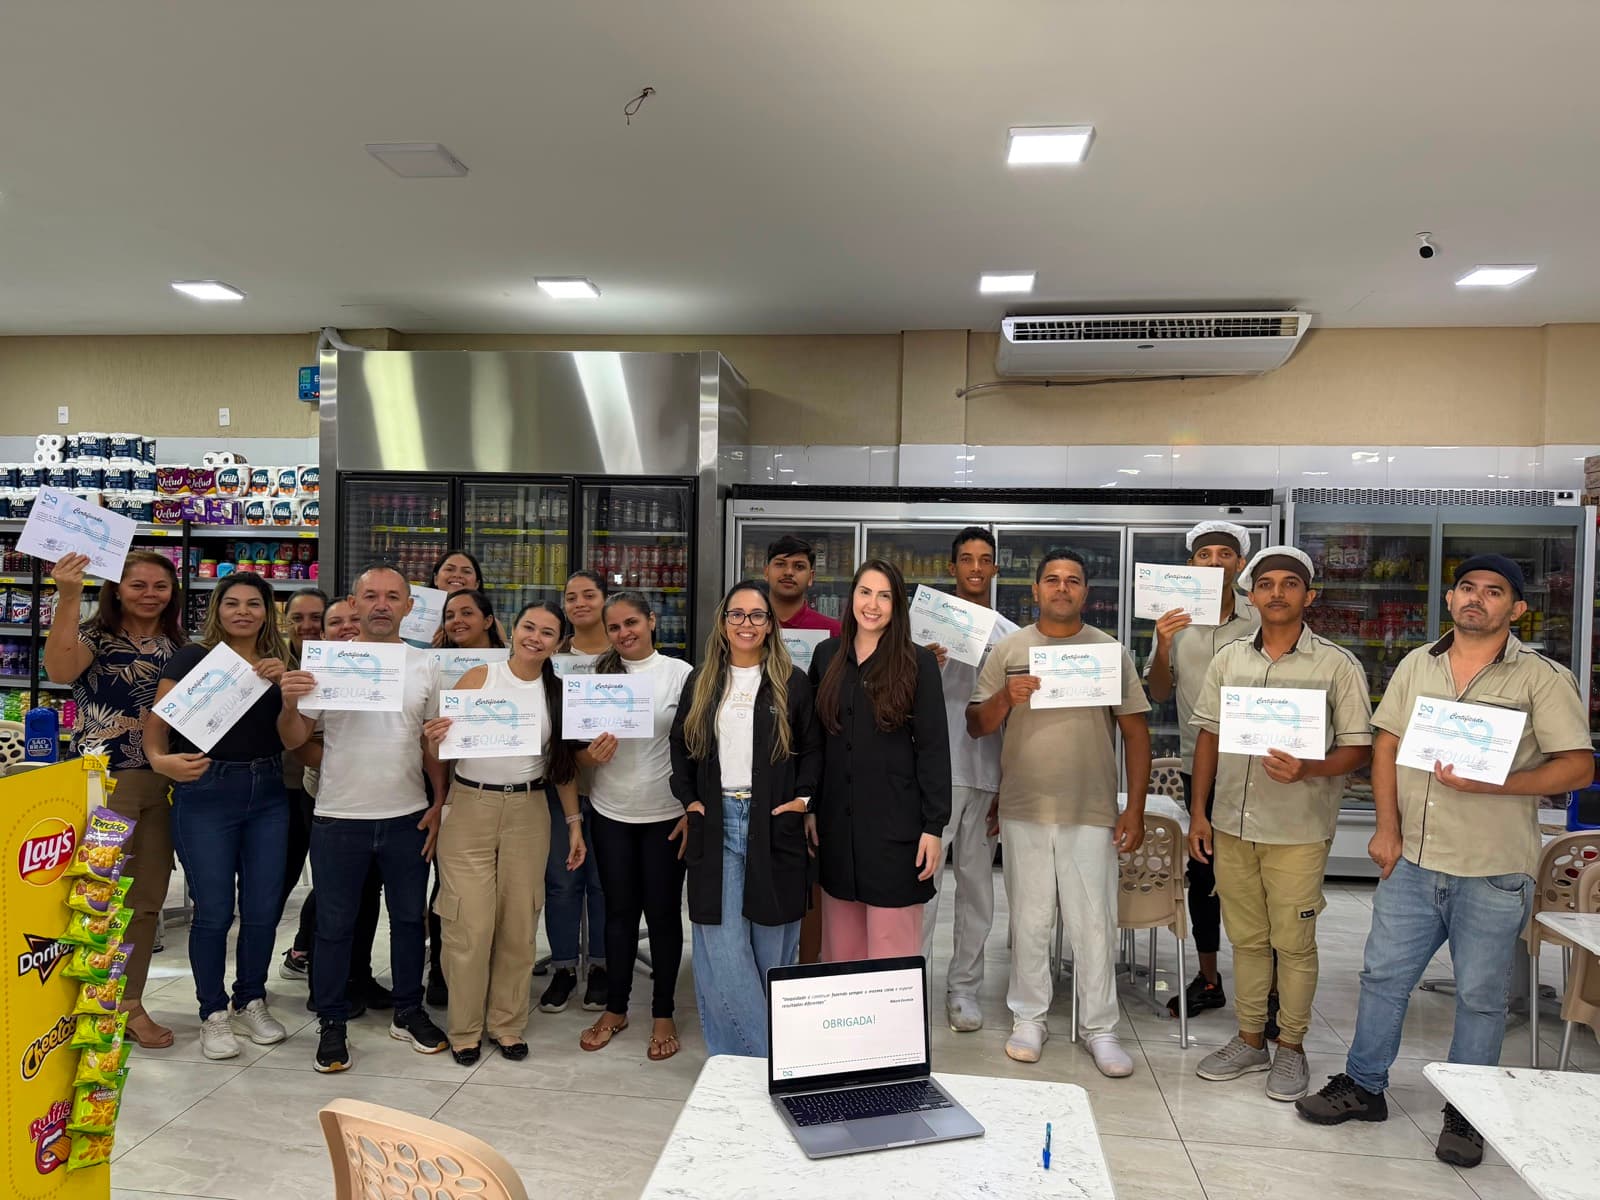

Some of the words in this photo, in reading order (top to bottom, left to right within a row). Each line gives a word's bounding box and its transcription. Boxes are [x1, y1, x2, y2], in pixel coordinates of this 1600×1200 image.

[219, 473, 238, 484] Mili
[92, 817, 127, 832] Torcida
[22, 830, 73, 874] Lay's
[19, 941, 75, 975] Dorito
[822, 1014, 876, 1030] OBRIGADA!
[29, 1100, 72, 1142] Ruffle
